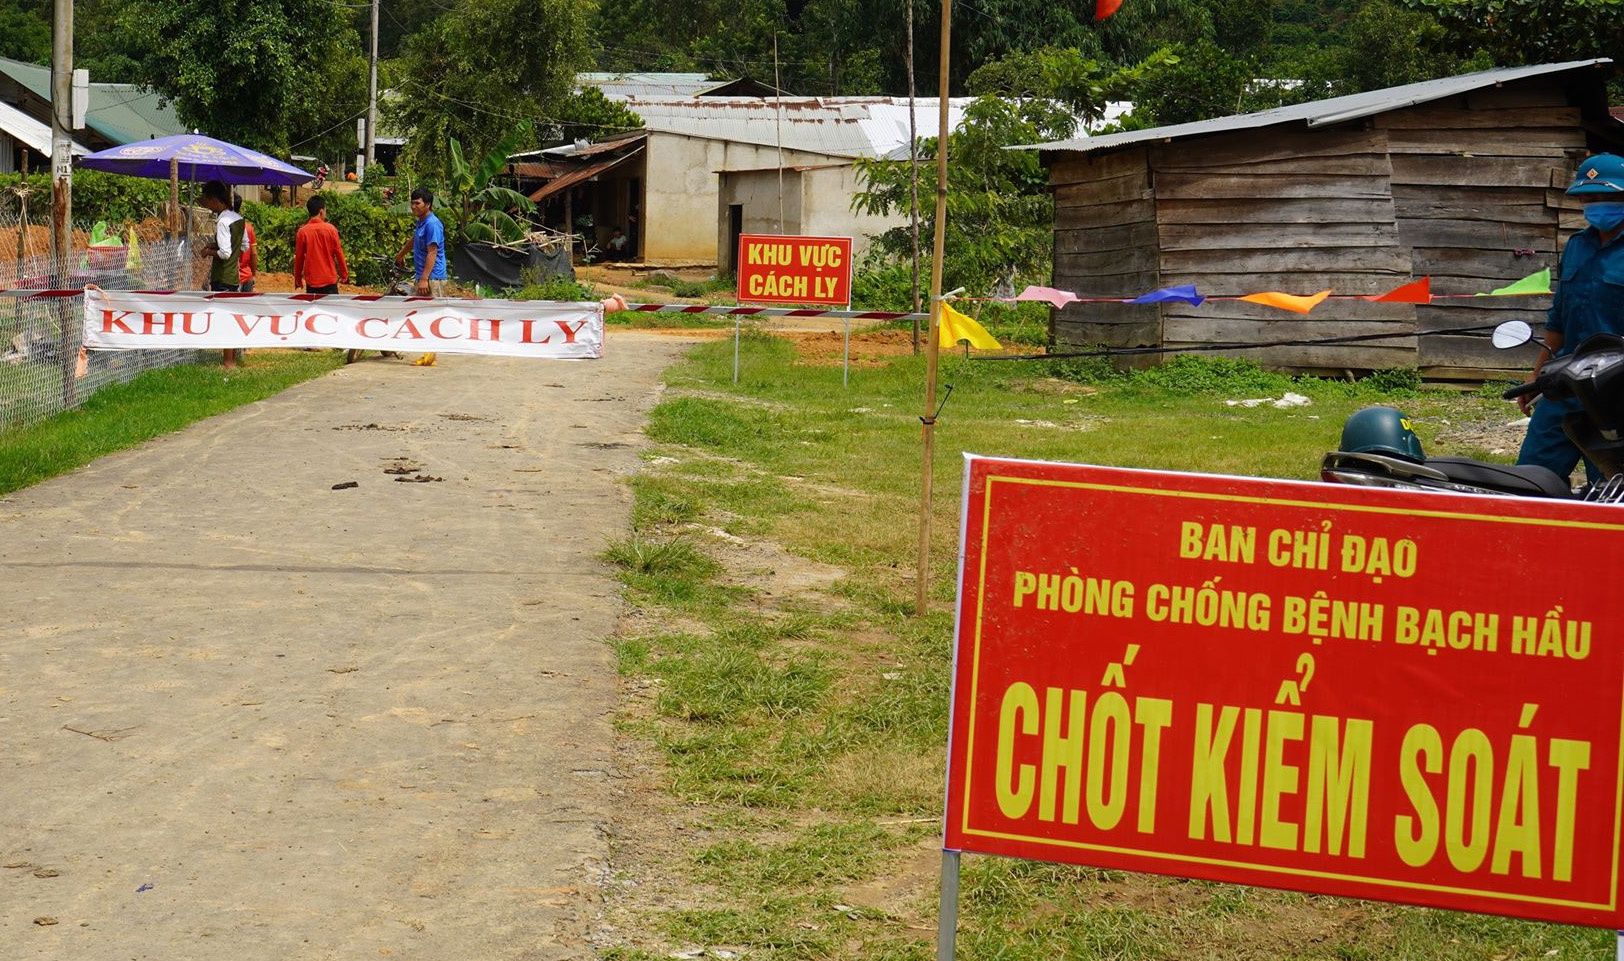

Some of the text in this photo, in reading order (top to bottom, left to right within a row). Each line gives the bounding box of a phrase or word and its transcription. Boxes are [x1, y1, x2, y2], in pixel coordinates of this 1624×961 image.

[748, 243, 842, 273] KHU VỰC
[749, 270, 839, 299] CÁCH LY
[99, 308, 589, 345] KHU VỰC CÁCH LY
[1180, 519, 1418, 584] BAN CHỈ ĐẠO
[1013, 566, 1592, 660] PHÒNG CHỐNG BỆNH BẠCH HẦU
[995, 643, 1591, 882] CHỐT KIỂM SOÁT
